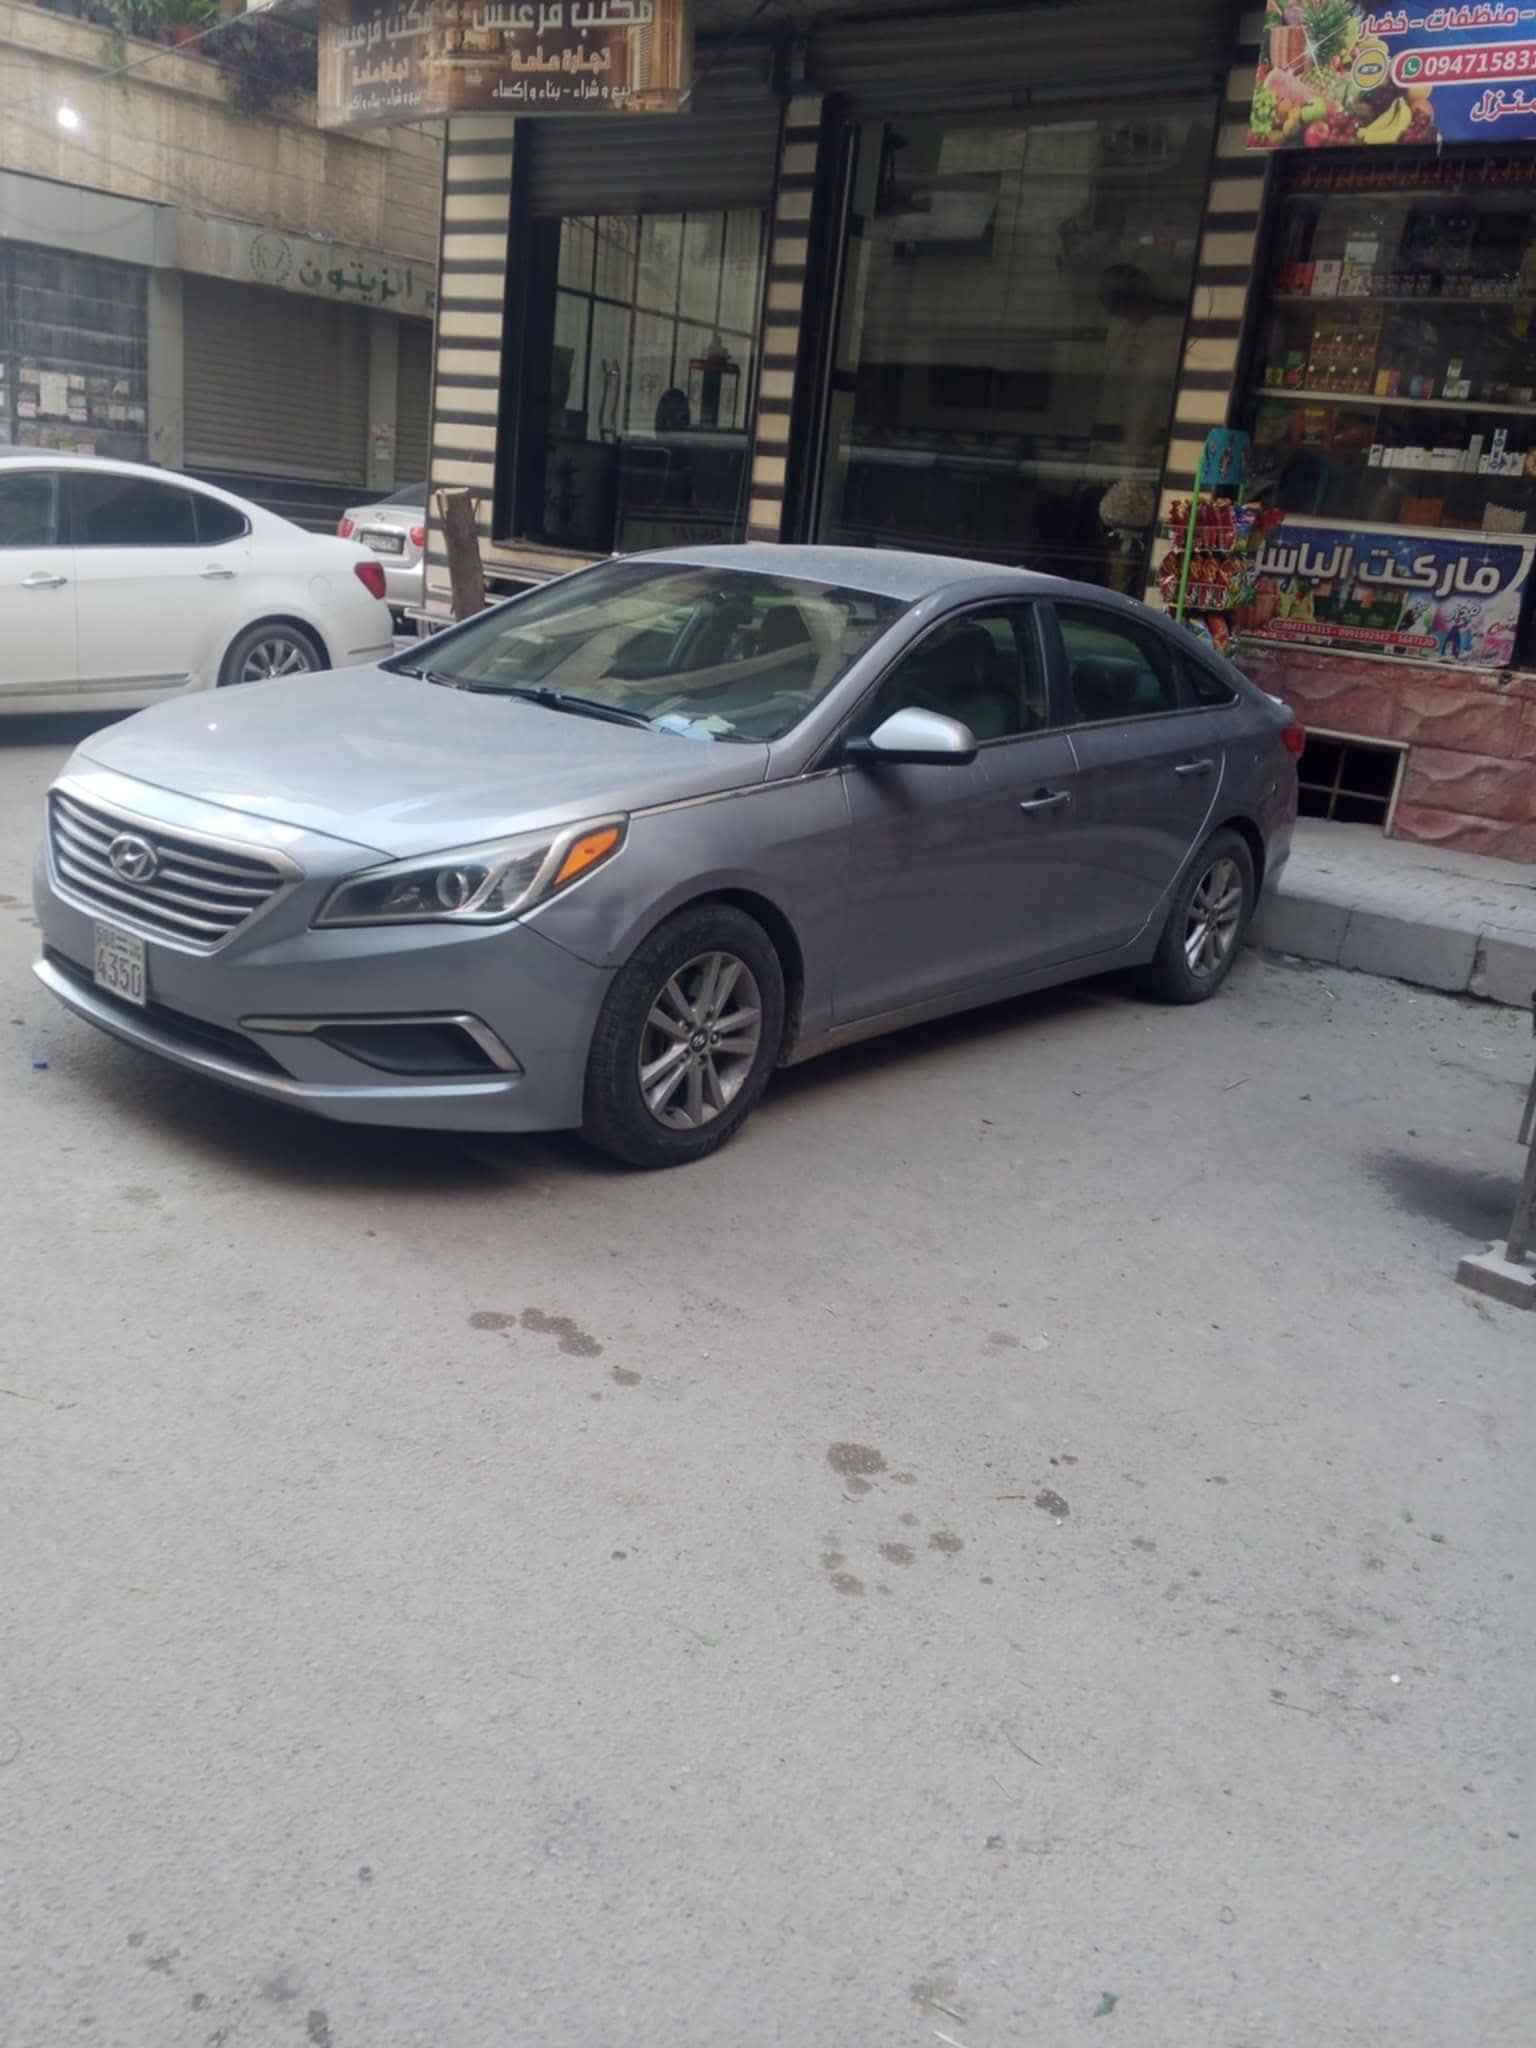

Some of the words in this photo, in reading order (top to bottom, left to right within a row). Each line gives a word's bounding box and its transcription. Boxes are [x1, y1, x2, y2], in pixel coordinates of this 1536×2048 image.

[571, 0, 653, 38] مكتب
[1359, 10, 1408, 42] خضار
[1424, 3, 1519, 32] منظفات
[299, 259, 413, 303] الزيتون
[1356, 549, 1501, 598] ماركت
